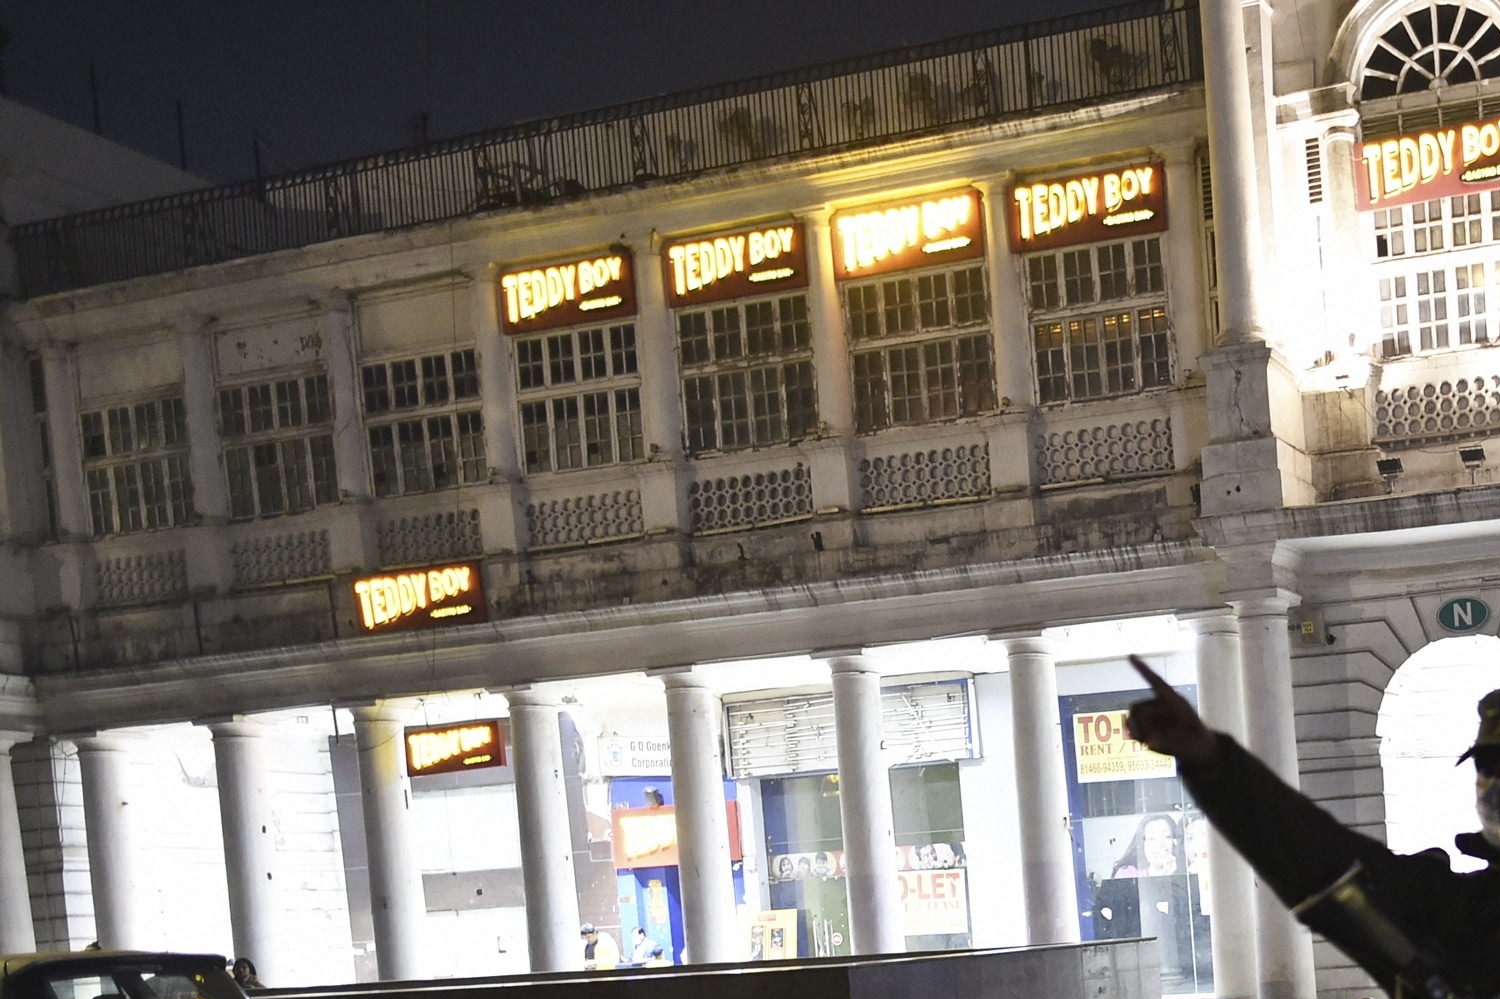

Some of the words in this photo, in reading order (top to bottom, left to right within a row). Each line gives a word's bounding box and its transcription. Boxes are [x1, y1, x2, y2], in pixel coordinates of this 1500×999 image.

[1362, 129, 1456, 204] TEDDY
[838, 206, 919, 272] TEDDY
[920, 194, 971, 239] BOY
[1015, 177, 1099, 240] TEDDY
[1103, 167, 1153, 211] BOY
[502, 264, 576, 324] TEDDY
[578, 256, 623, 295] BOY
[669, 236, 746, 296] TEDDY
[748, 227, 794, 265] BOY
[355, 573, 427, 630] TEDDY
[428, 566, 470, 603] BOY
[1453, 602, 1473, 627] N
[630, 741, 636, 751] G
[638, 741, 644, 751] D
[646, 739, 671, 751] Goenk
[1078, 713, 1131, 743] TO-L
[1080, 743, 1112, 756] RENT
